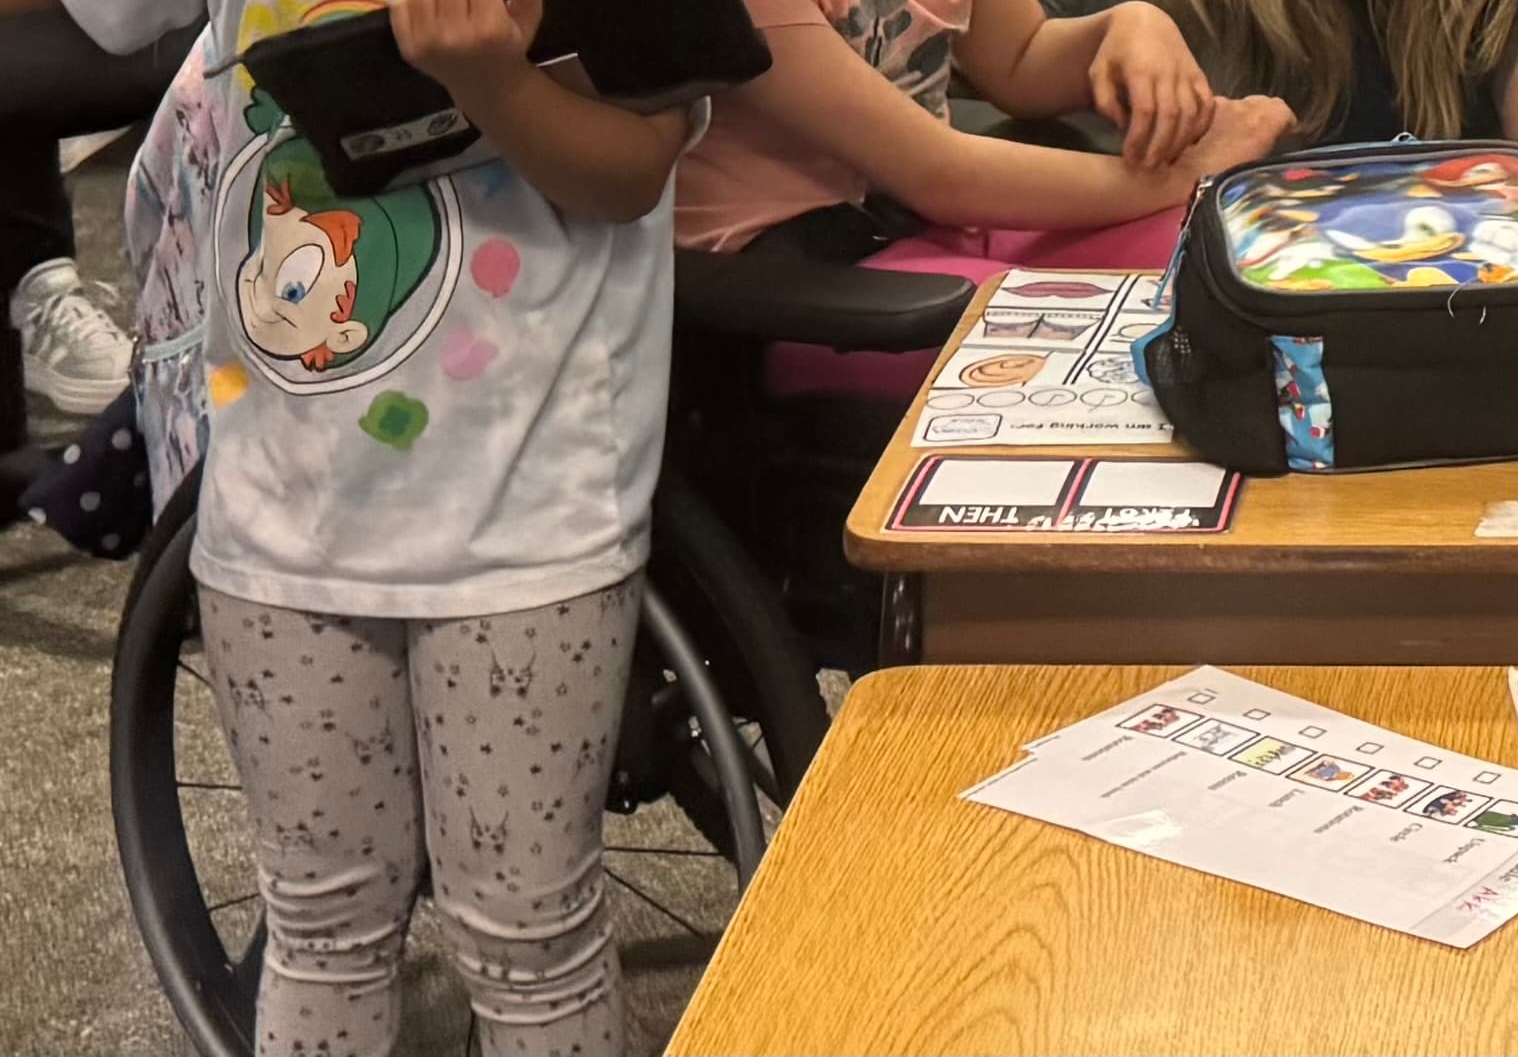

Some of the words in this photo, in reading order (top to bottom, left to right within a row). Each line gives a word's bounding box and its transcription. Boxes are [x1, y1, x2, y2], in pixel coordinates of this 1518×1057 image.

[939, 506, 1018, 523] THEN
[1390, 822, 1423, 842] Circle
[1443, 838, 1485, 863] Unpack
